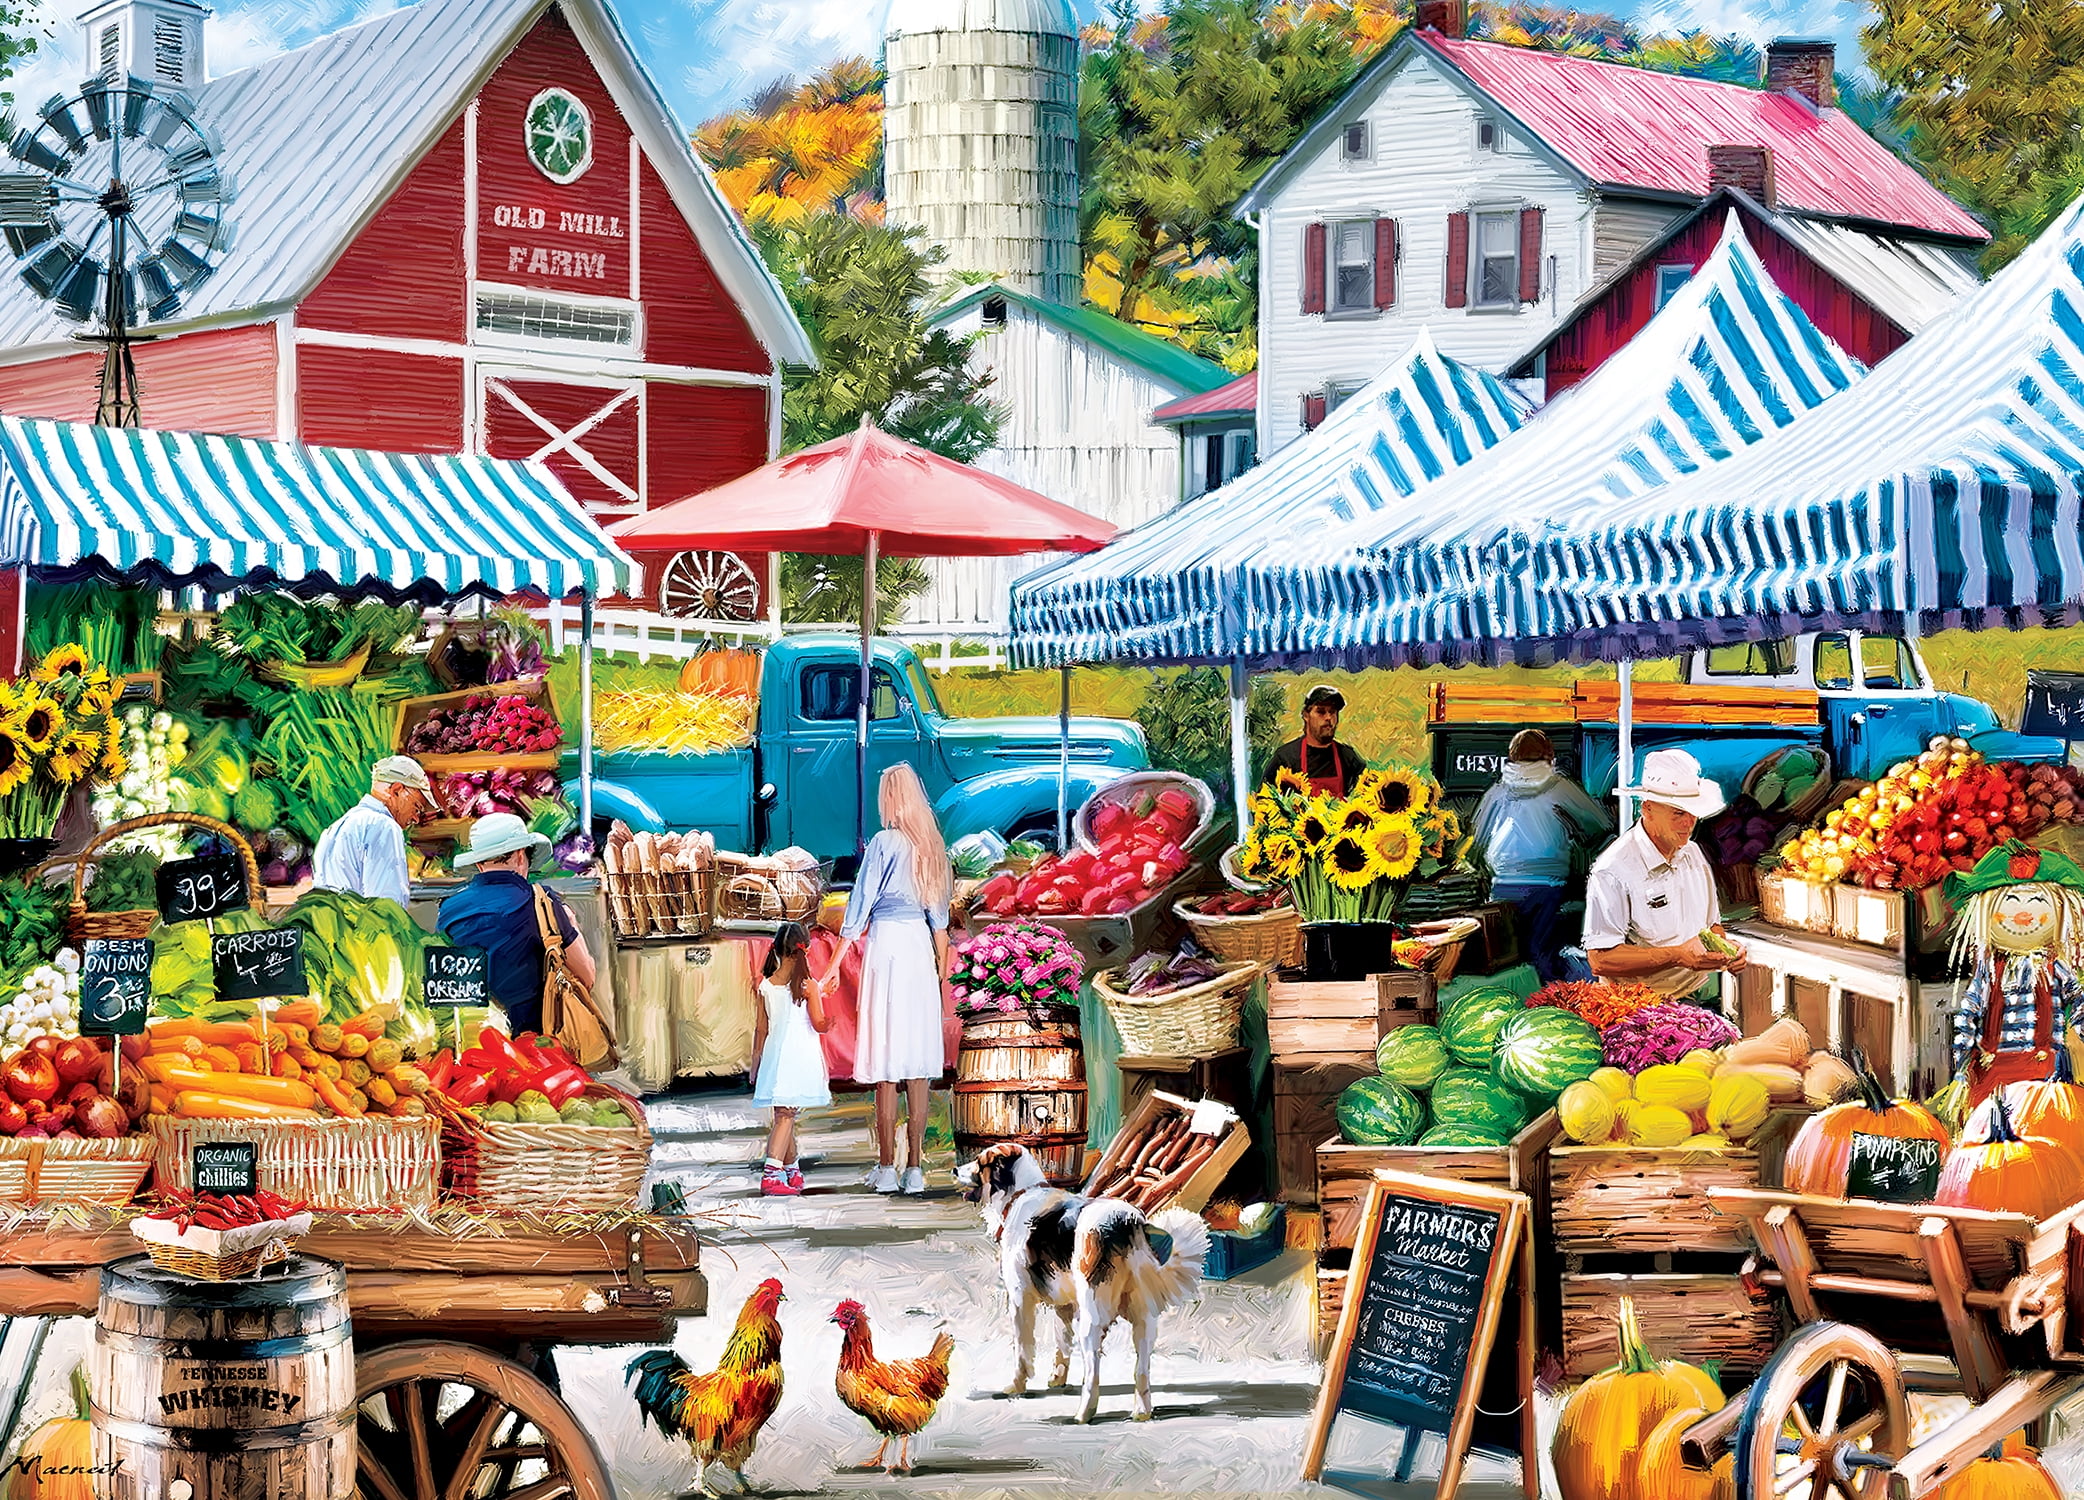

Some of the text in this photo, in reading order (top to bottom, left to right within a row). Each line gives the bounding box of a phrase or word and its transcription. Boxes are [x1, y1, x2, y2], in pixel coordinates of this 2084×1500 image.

[493, 205, 625, 238] OLD MILL
[507, 245, 607, 279] FARM
[215, 929, 298, 956] CARROTS
[85, 952, 149, 973] ONIONS
[429, 953, 482, 977] 100%
[426, 979, 486, 1000] ORGANIC
[196, 1148, 251, 1163] ORGANIC
[1852, 1133, 1939, 1171] PUMPKINS
[198, 1167, 249, 1187] chillies
[1384, 1205, 1498, 1250] FARMERS
[1396, 1235, 1470, 1268] Market
[1384, 1307, 1448, 1336] CHEESES
[180, 1367, 267, 1380] TENNESSE
[158, 1386, 302, 1415] WHISKEY
